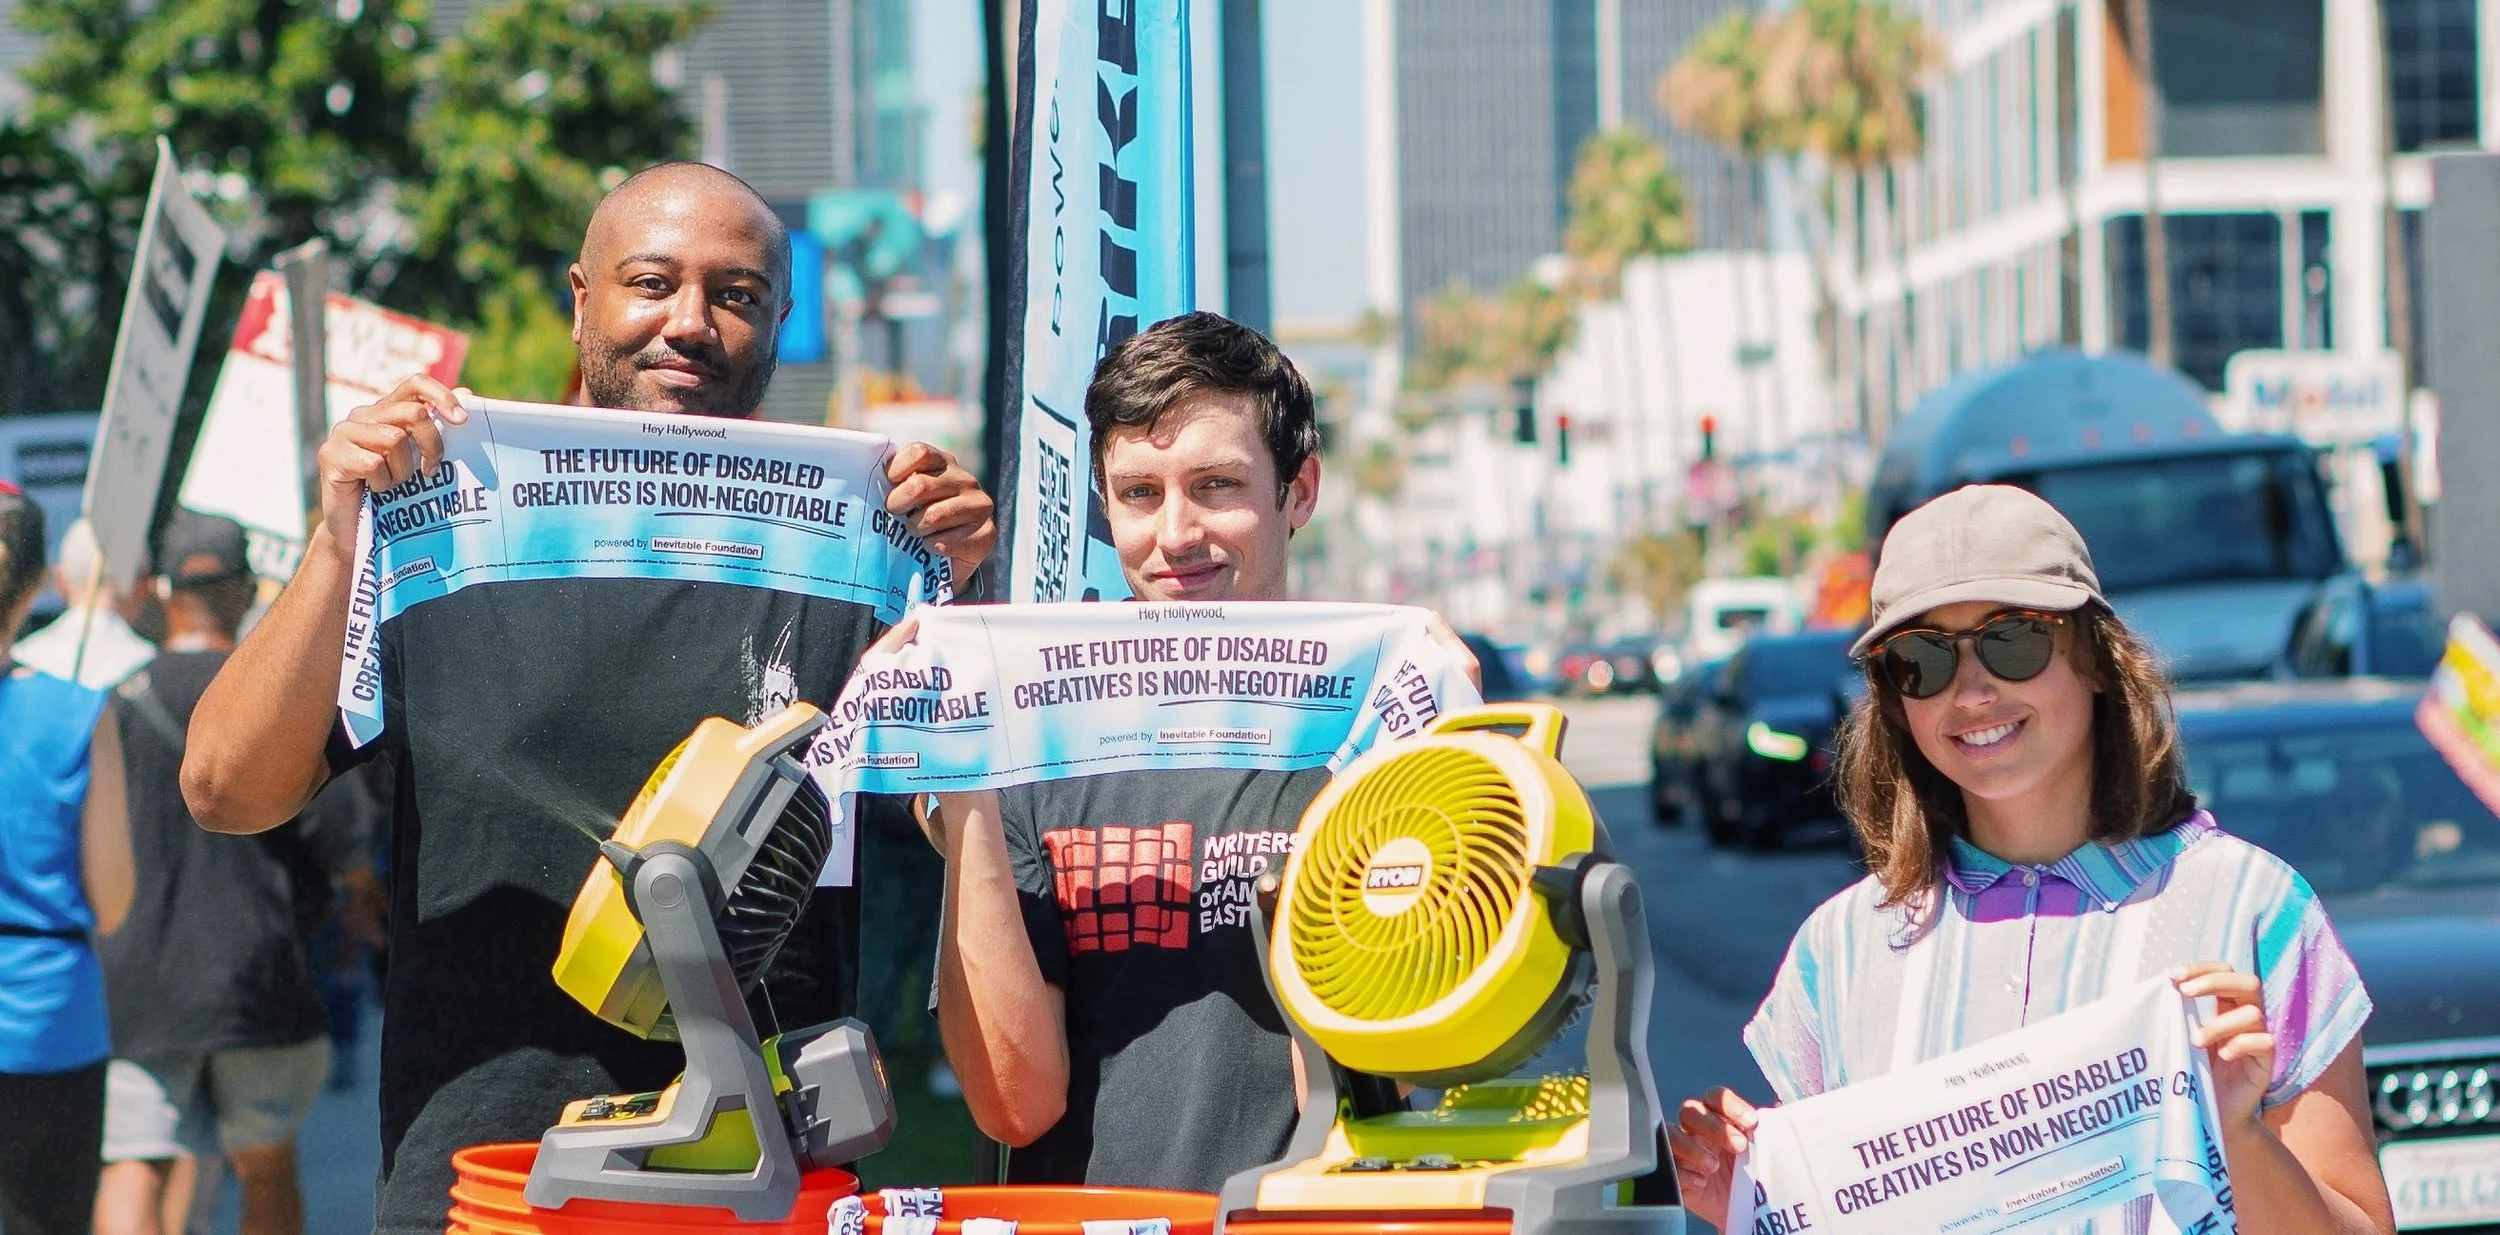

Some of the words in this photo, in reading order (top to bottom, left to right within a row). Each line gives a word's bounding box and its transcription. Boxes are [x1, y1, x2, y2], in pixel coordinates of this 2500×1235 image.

[642, 423, 664, 437] Hey
[540, 448, 585, 474] THE
[590, 448, 679, 475] FUTURE
[683, 451, 713, 476] OF
[716, 453, 825, 490] DISABLED
[512, 480, 631, 508] CREATIVES
[636, 481, 656, 506] IS
[661, 482, 848, 528] NON-NEGOTIABLE
[594, 538, 634, 549] powered
[636, 538, 648, 550] by
[653, 539, 702, 551] Inevitable
[705, 541, 759, 556] Foundation
[1139, 607, 1160, 623] Hey
[1163, 605, 1226, 622] Hollywood,
[1039, 643, 1086, 673] THE
[1089, 637, 1178, 667] FUTURE
[1184, 636, 1213, 662] OF
[1217, 636, 1328, 666] DISABLED
[1014, 672, 1132, 710] CREATIVES
[1138, 671, 1158, 697] IS
[1163, 669, 1355, 699] NON-NEGOTIABLE
[1099, 731, 1138, 746] powered
[1140, 731, 1153, 743] by
[1160, 729, 1206, 740] Inevitable
[1209, 729, 1267, 741] Foundation
[1204, 831, 1300, 860] WRITERS
[1201, 855, 1268, 883] GUILD
[1367, 865, 1422, 889] RYOBI
[1200, 905, 1251, 934] EAST
[1852, 1132, 1905, 1169] THE
[1903, 1099, 1999, 1150] FUTURE
[1999, 1087, 2029, 1121] OF
[2032, 1046, 2148, 1110] DISABLED
[1835, 1151, 1963, 1216] CREATIVES
[1964, 1141, 1990, 1172] IS
[1989, 1076, 2163, 1163] NON-NEGOTIAB
[2060, 1160, 2120, 1191] Foundation
